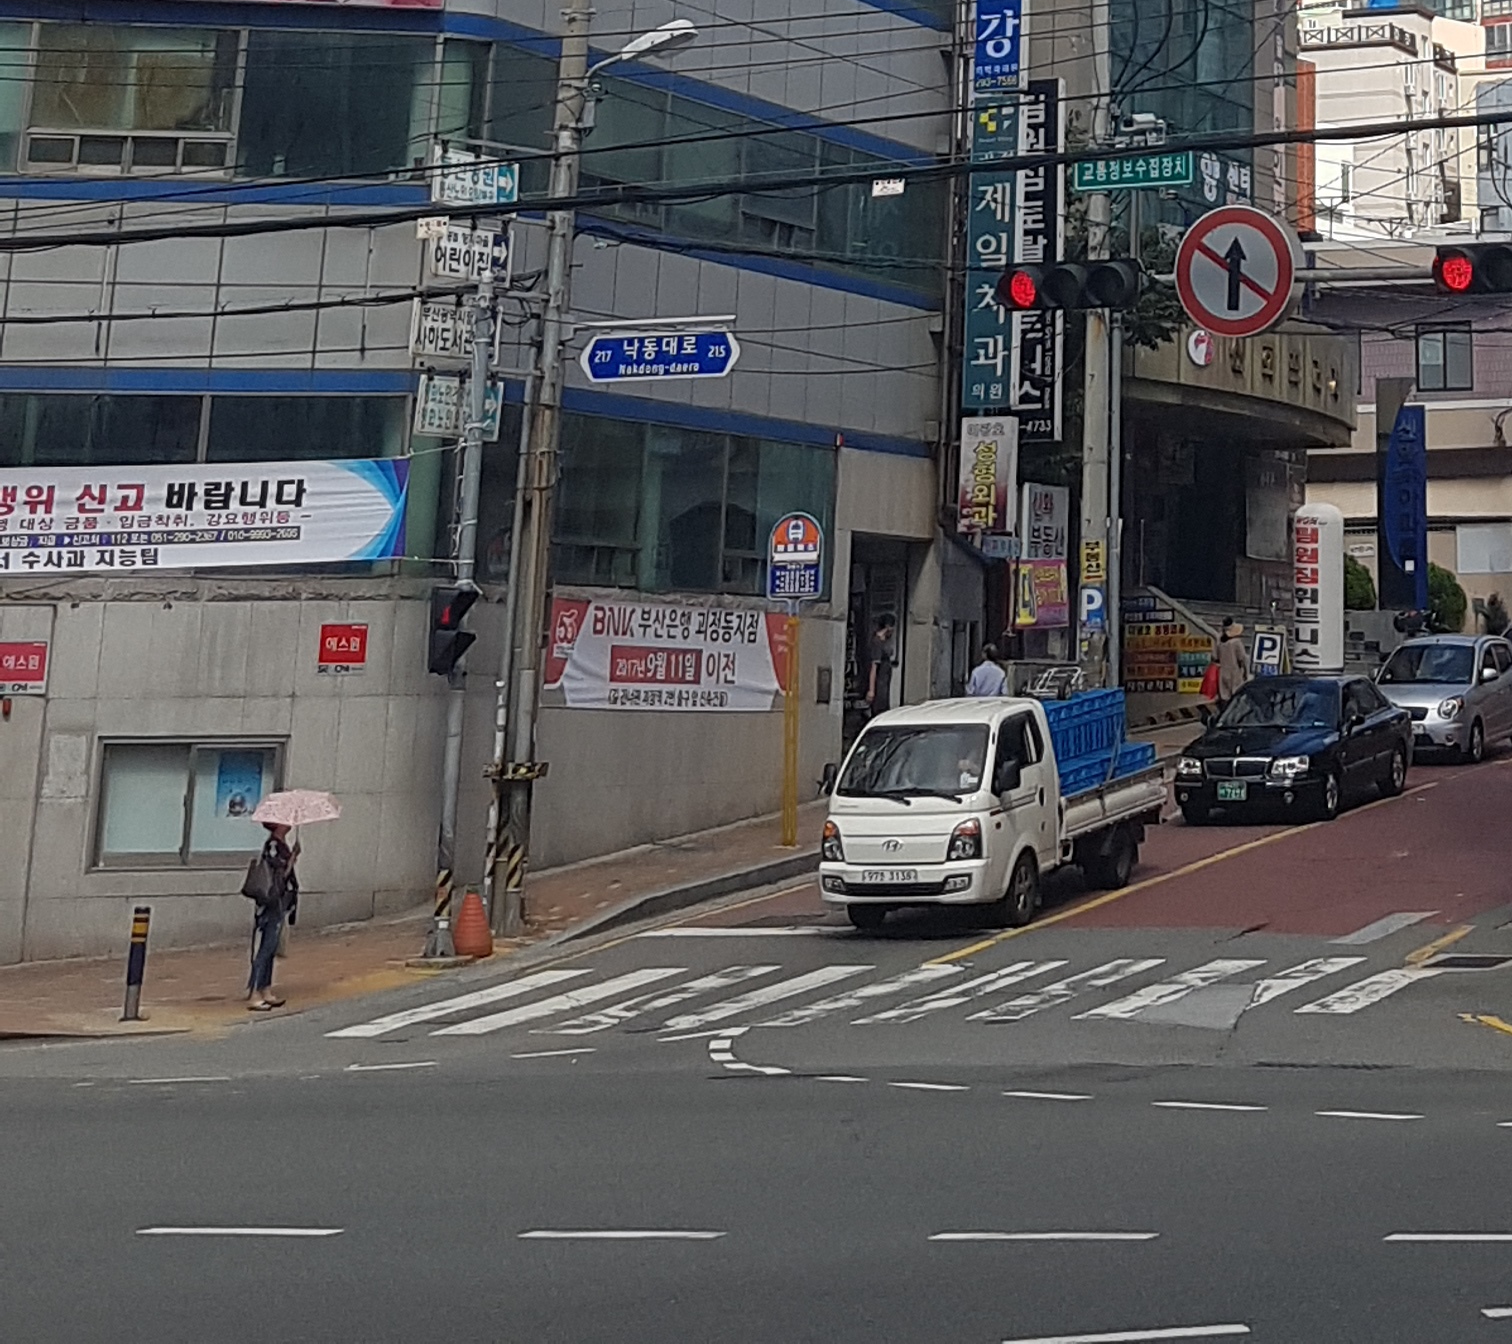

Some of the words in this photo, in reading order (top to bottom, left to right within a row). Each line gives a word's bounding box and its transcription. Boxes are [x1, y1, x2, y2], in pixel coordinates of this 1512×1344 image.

[1082, 156, 1187, 181] 교통정보수집장치
[970, 178, 1009, 376] 제일치과
[594, 350, 613, 363] 217
[623, 336, 698, 359] 낙동대로
[708, 345, 726, 359] 215
[971, 383, 1002, 400] 의원
[75, 483, 145, 513] 신고
[165, 478, 307, 511] 바랍니다
[20, 517, 54, 531] 대상
[111, 532, 128, 544] 112
[21, 550, 86, 570] 수사과
[94, 548, 159, 567] 지능팀
[1082, 588, 1103, 620] P
[592, 606, 634, 638] BNK
[638, 608, 691, 639] 부산은행
[694, 612, 759, 643] 괴정동지점
[1256, 636, 1277, 660] P
[646, 653, 667, 679] 9월
[670, 654, 696, 680] 11일
[706, 652, 736, 684] 이전
